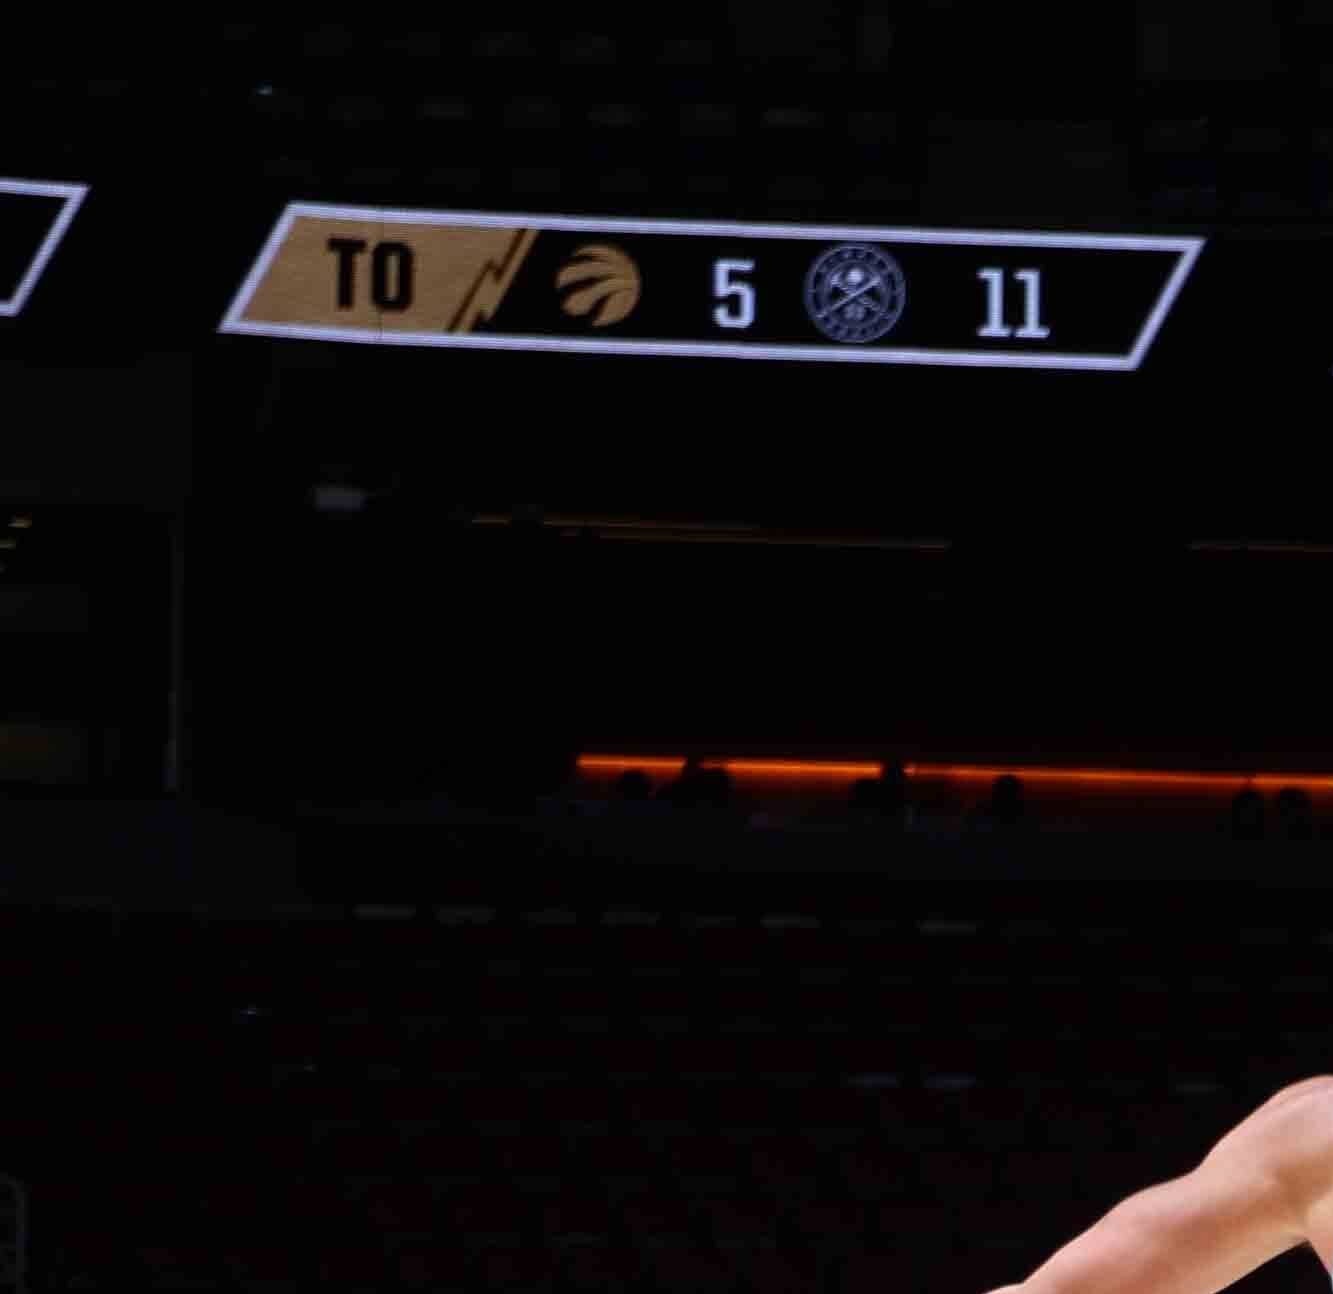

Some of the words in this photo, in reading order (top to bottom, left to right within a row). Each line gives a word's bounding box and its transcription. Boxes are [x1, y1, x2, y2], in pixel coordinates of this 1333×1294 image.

[326, 237, 418, 314] TO
[713, 260, 756, 330] 5
[977, 268, 1050, 339] 11
